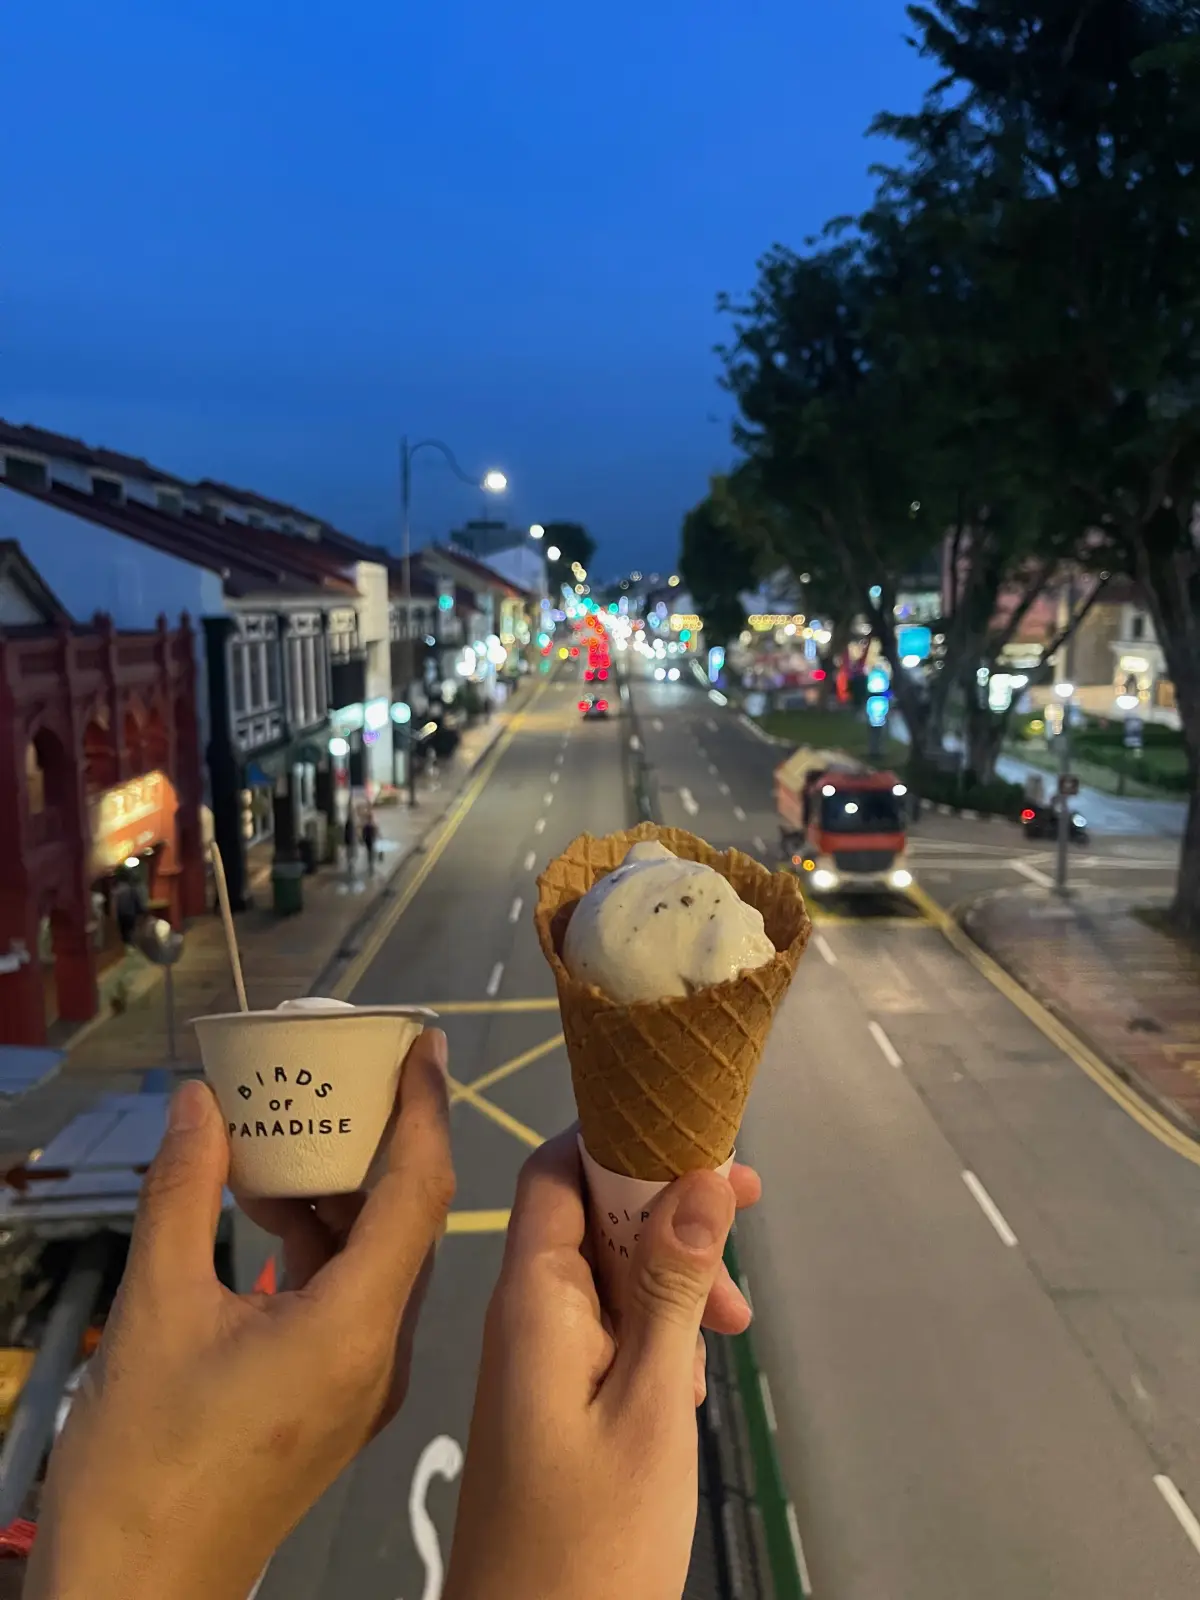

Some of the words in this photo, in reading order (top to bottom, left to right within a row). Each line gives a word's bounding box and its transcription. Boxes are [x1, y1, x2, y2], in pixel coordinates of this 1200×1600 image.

[237, 1066, 333, 1100] BIRDS
[269, 1099, 294, 1111] OF
[228, 1118, 352, 1138] PARADISE
